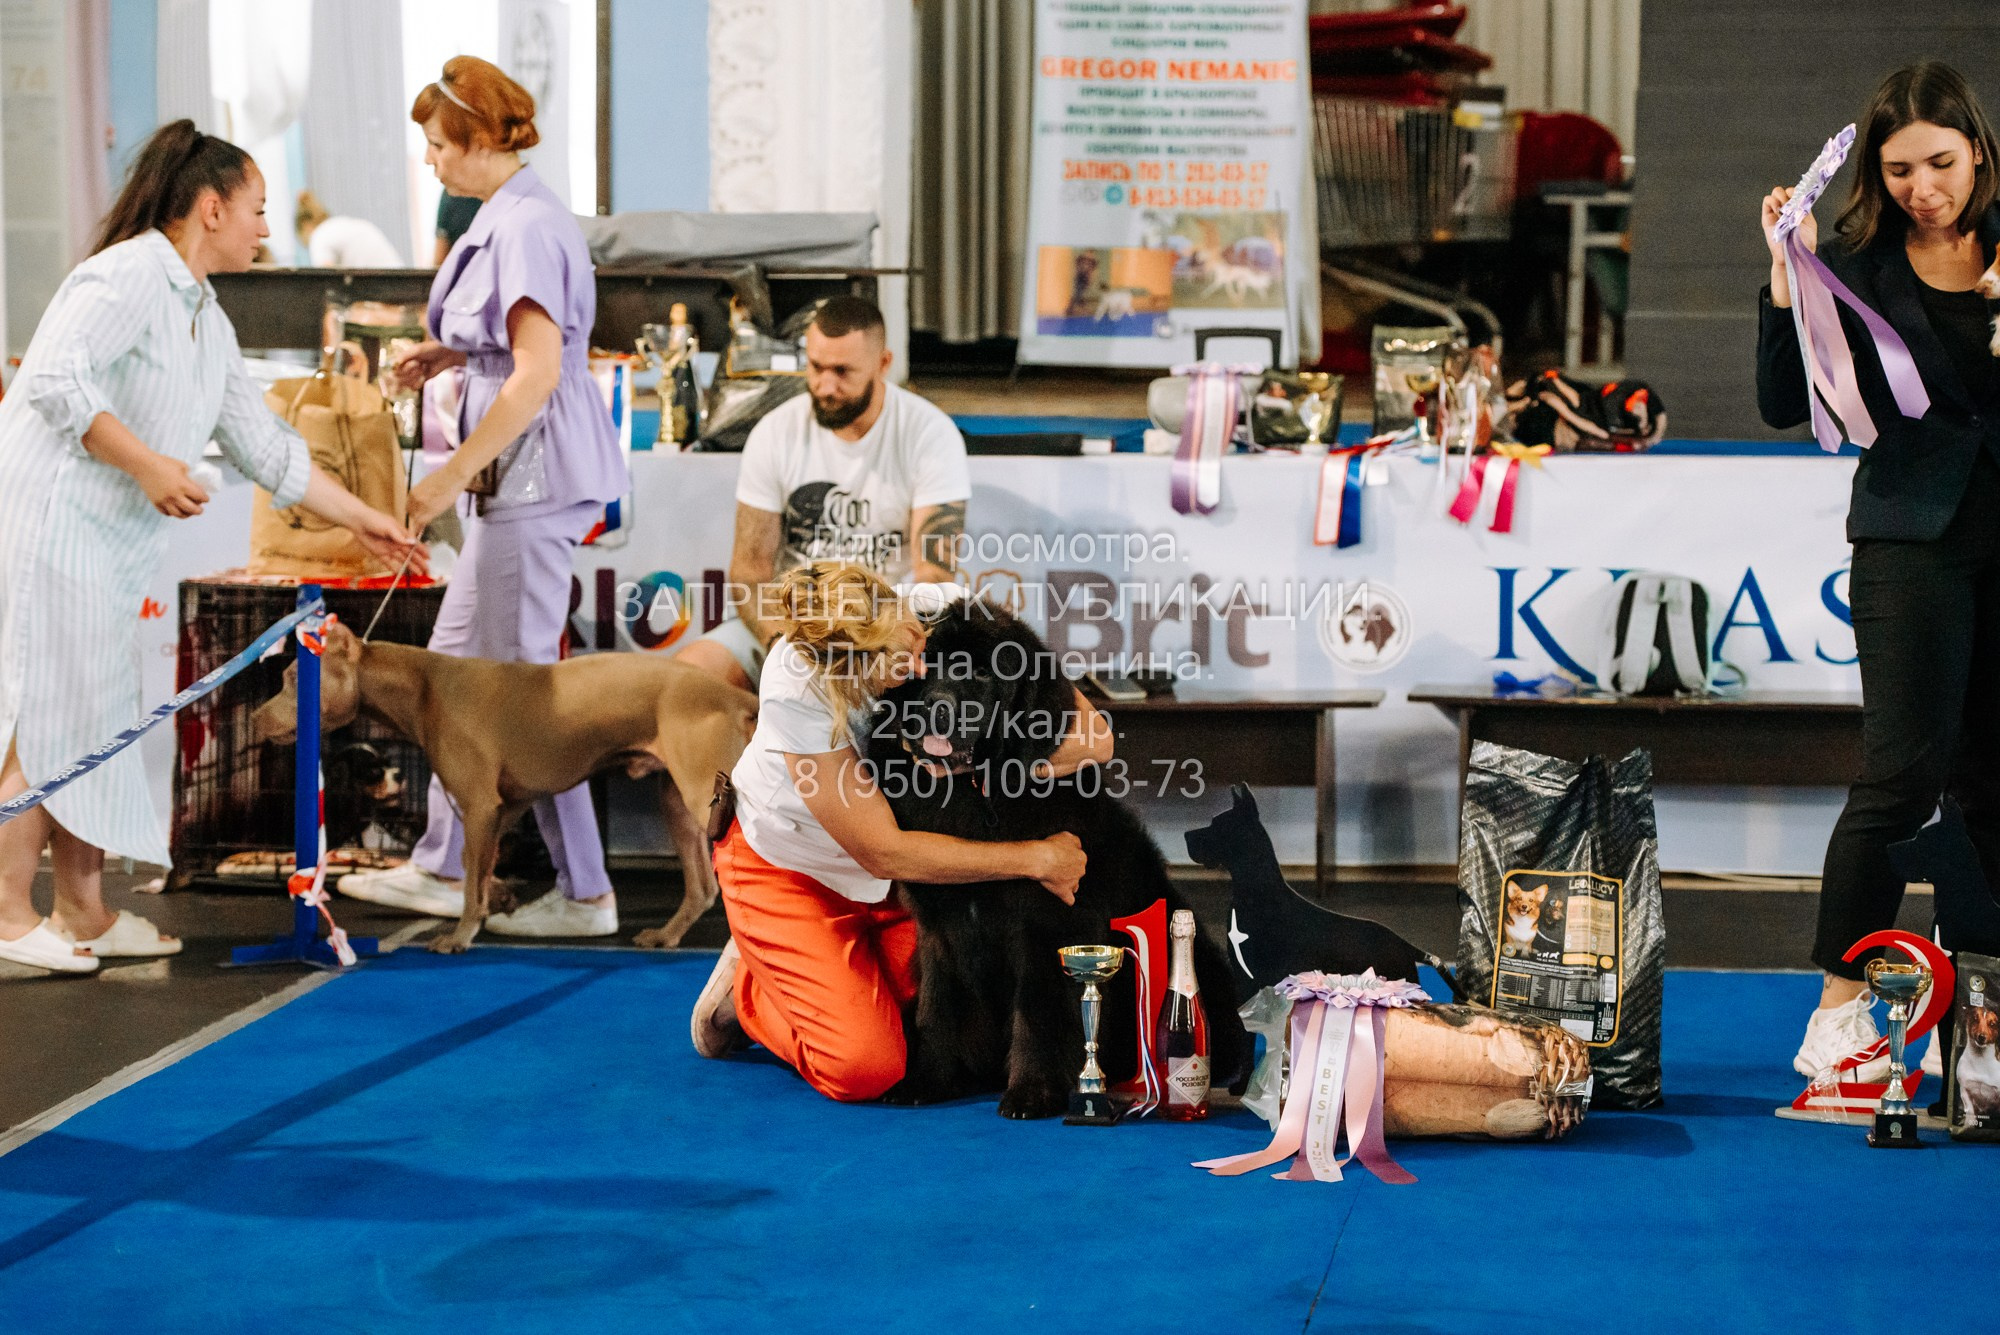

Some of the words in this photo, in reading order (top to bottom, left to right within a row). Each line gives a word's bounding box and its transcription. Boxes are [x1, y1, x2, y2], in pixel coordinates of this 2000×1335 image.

[1040, 56, 1158, 79] GREGOR
[1167, 59, 1297, 81] NEMANIC
[1062, 160, 1132, 181] ЗАПИСЬ
[1137, 161, 1162, 181] ПО
[1046, 571, 1271, 669] Brit
[1084, 1099, 1096, 1117] 1
[1313, 1067, 1332, 1126] BEST
[1889, 1121, 1903, 1139] 2
